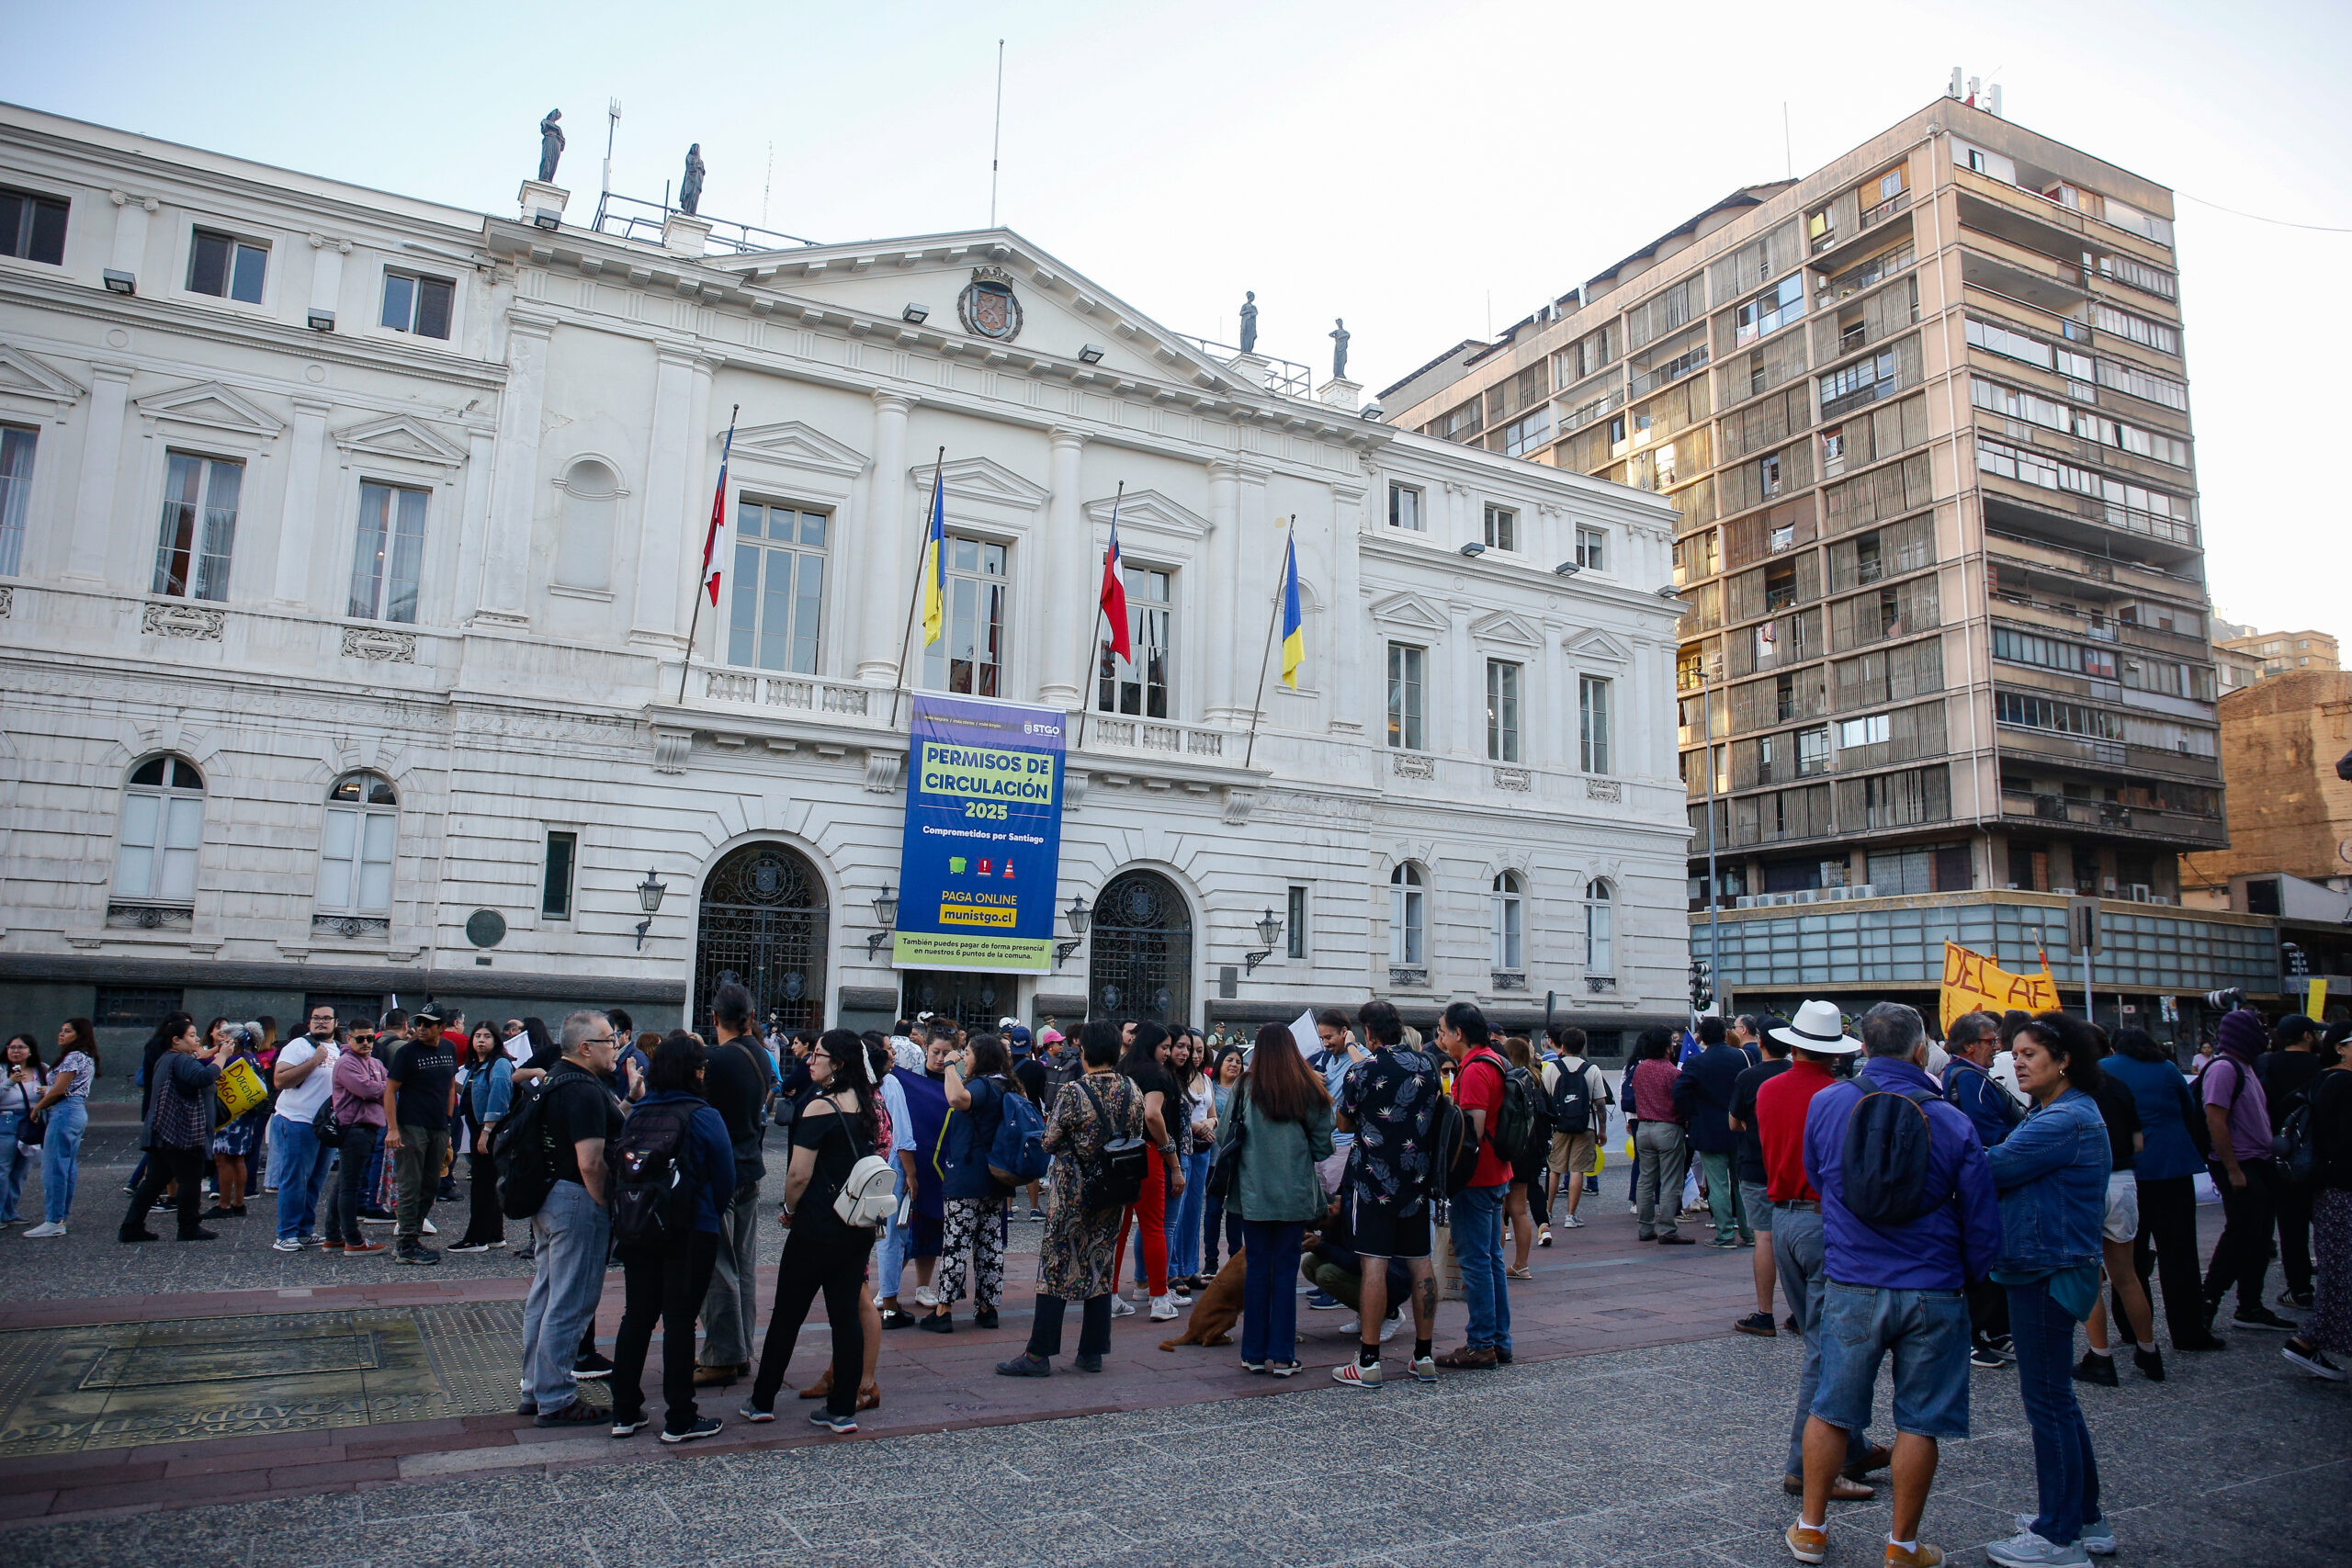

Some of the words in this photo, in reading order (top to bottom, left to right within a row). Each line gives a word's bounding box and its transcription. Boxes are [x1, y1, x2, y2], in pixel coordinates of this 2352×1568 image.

[1033, 724, 1060, 735] STGO
[927, 747, 1022, 773] PERMISOS
[1027, 759, 1049, 775] DE
[925, 773, 1048, 799] CIRCULACIÓN
[965, 801, 1009, 820] 2025
[922, 825, 990, 840] Comprometidos
[992, 833, 1006, 841] por
[1009, 833, 1045, 844] Santiago
[942, 890, 972, 903] PAGA
[975, 893, 1018, 905] ONLINE
[944, 909, 1012, 924] munistgo.cl
[902, 937, 932, 946] También
[933, 941, 958, 949] puedes
[960, 942, 979, 951] pagar
[991, 942, 1011, 951] forma
[1012, 944, 1045, 953] presencial
[962, 950, 985, 958] puntos
[987, 950, 995, 958] de
[1944, 945, 1997, 999] DEL
